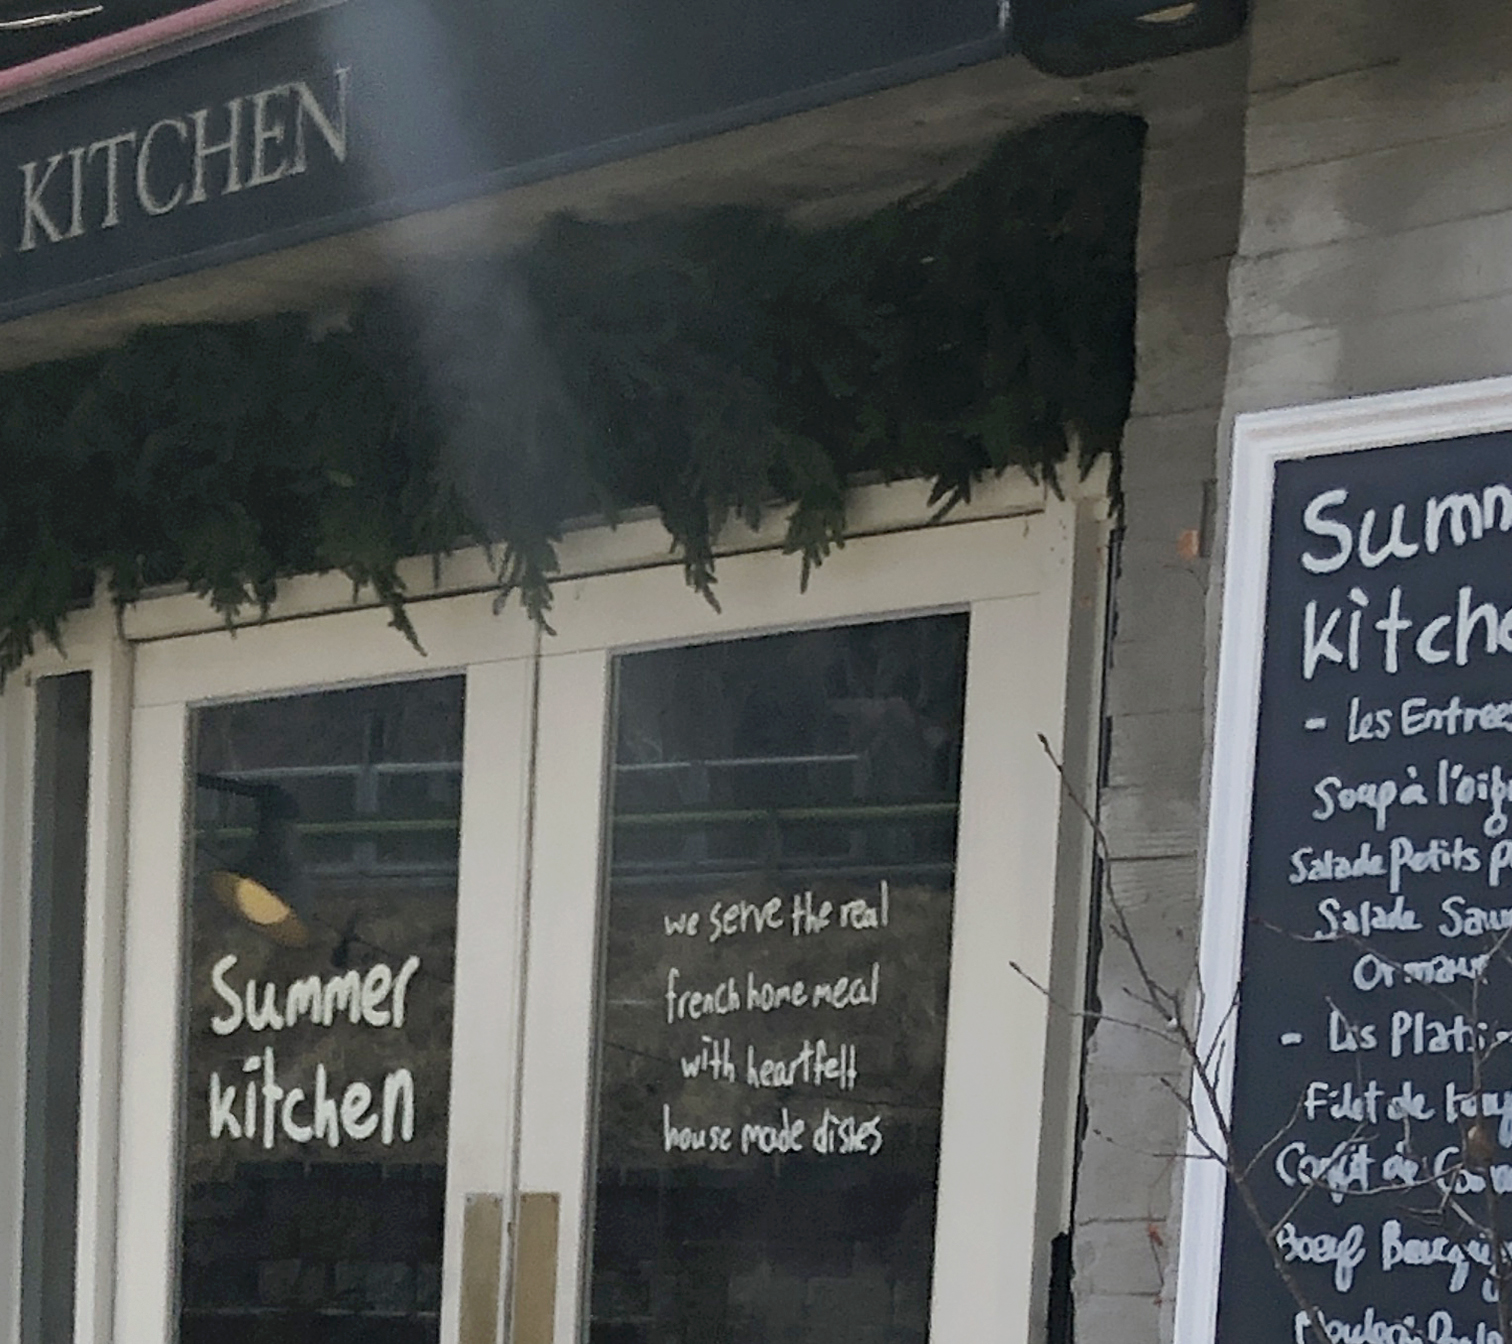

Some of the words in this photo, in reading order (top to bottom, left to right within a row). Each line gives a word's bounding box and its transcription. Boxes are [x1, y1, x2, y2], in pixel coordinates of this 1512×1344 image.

[16, 64, 352, 252] KITCHEN
[1288, 845, 1387, 885] Salade
[664, 912, 700, 936] we
[708, 897, 785, 942] serve
[791, 891, 834, 936] the
[840, 880, 889, 930] real
[1316, 895, 1423, 941] Salade
[210, 953, 422, 1036] Summer
[665, 967, 740, 1025] french
[746, 972, 808, 1011] home
[812, 962, 880, 1009] meal
[681, 1036, 735, 1083] with
[662, 1103, 732, 1152] house
[741, 1107, 806, 1155] made
